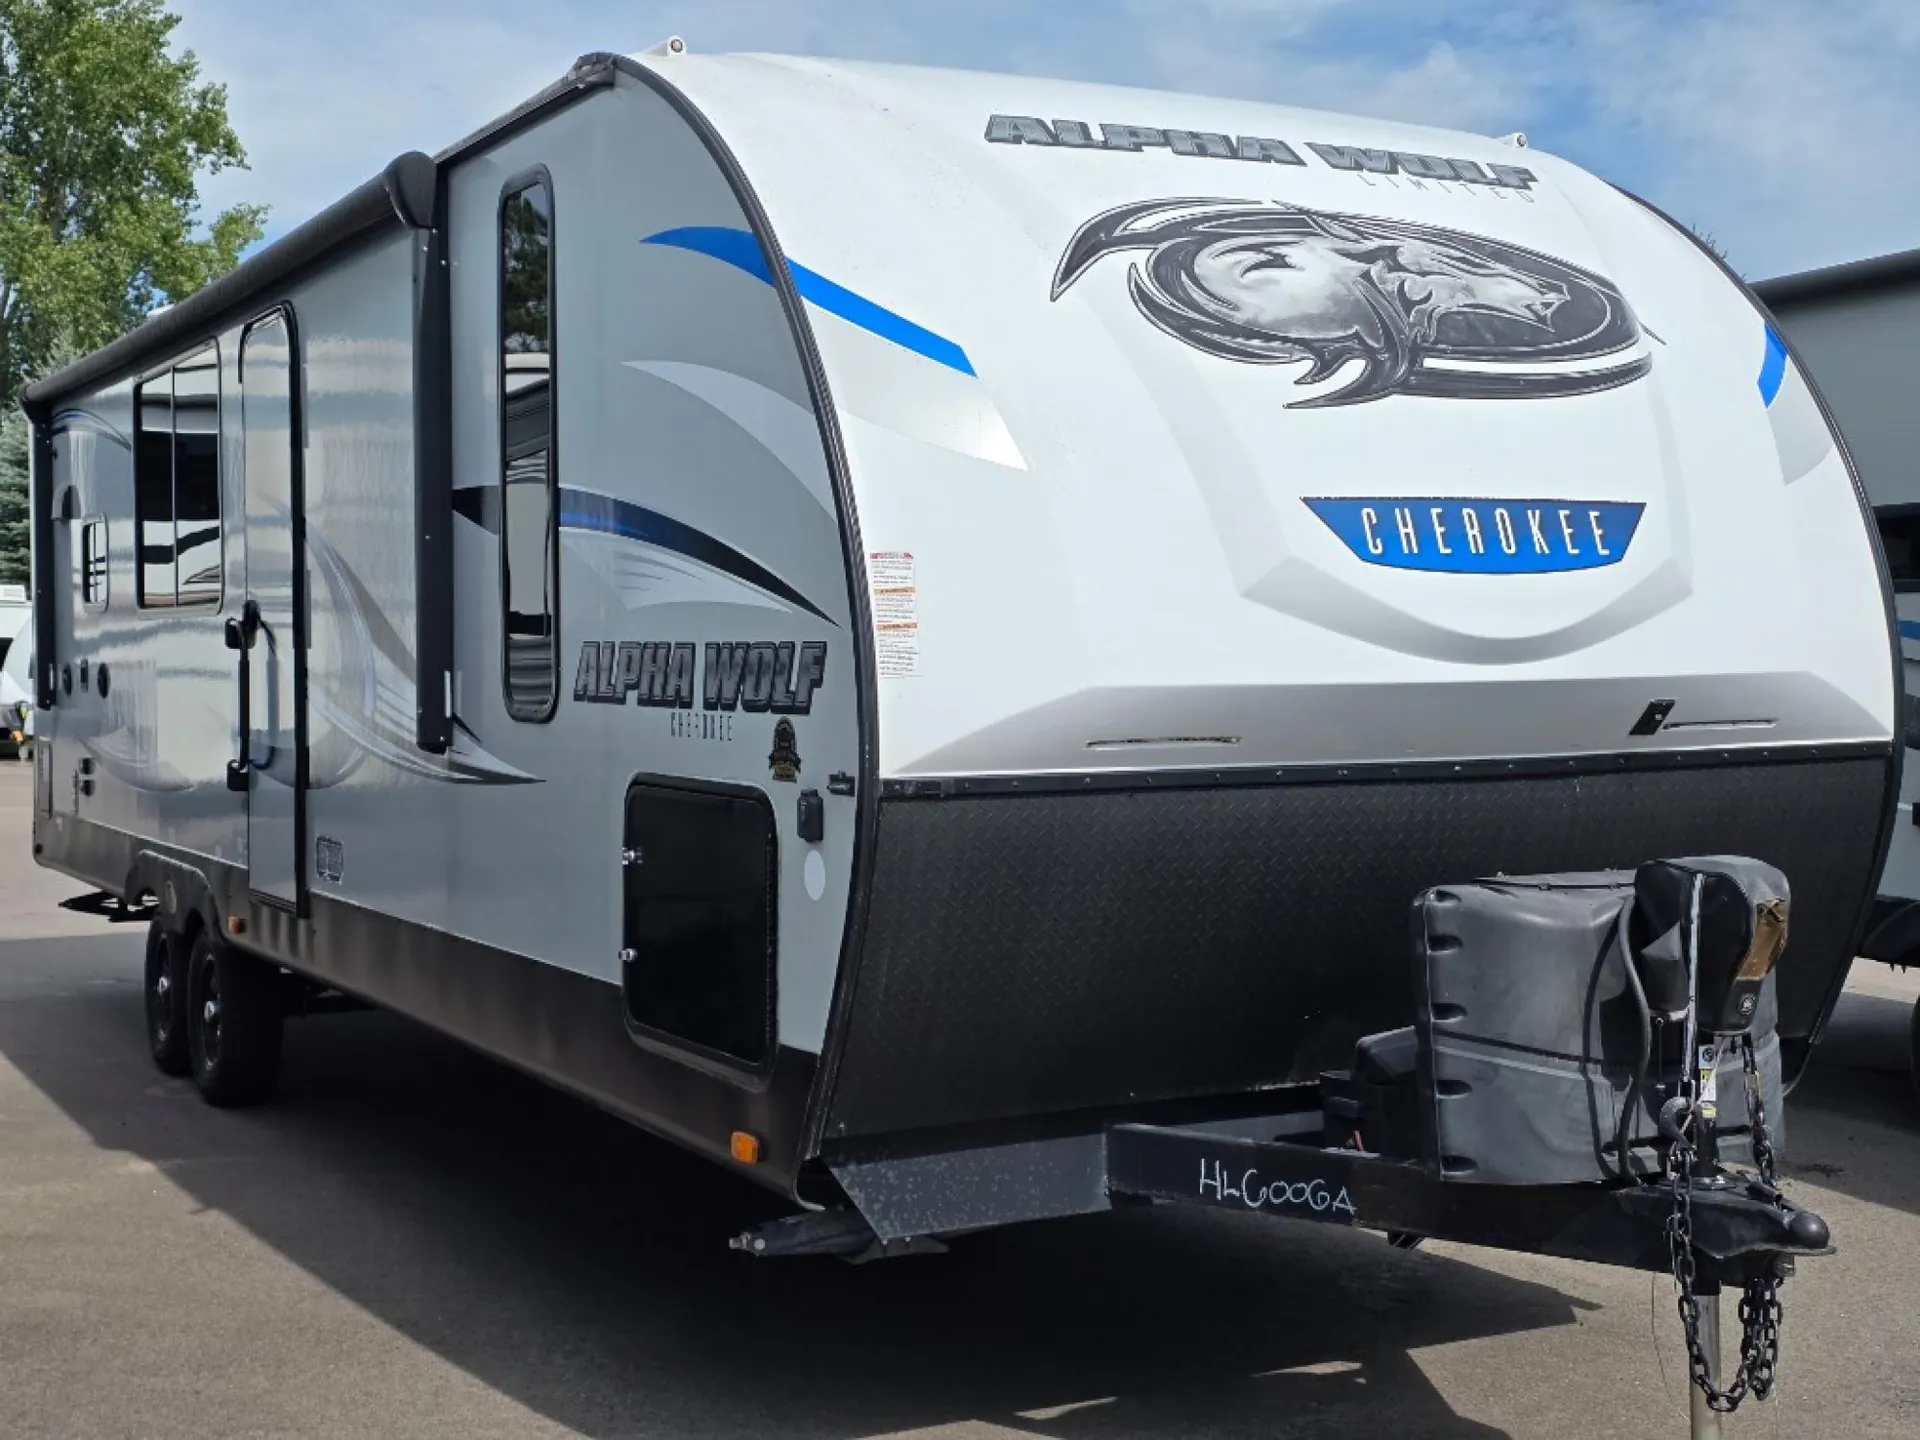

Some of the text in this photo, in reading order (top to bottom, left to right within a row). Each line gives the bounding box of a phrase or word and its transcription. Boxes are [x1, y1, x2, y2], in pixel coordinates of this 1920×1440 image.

[984, 114, 1539, 190] ALPHA WOLF
[1361, 507, 1611, 556] CHEROKEE
[573, 641, 697, 709] ALPHA
[703, 641, 828, 715] WOLF
